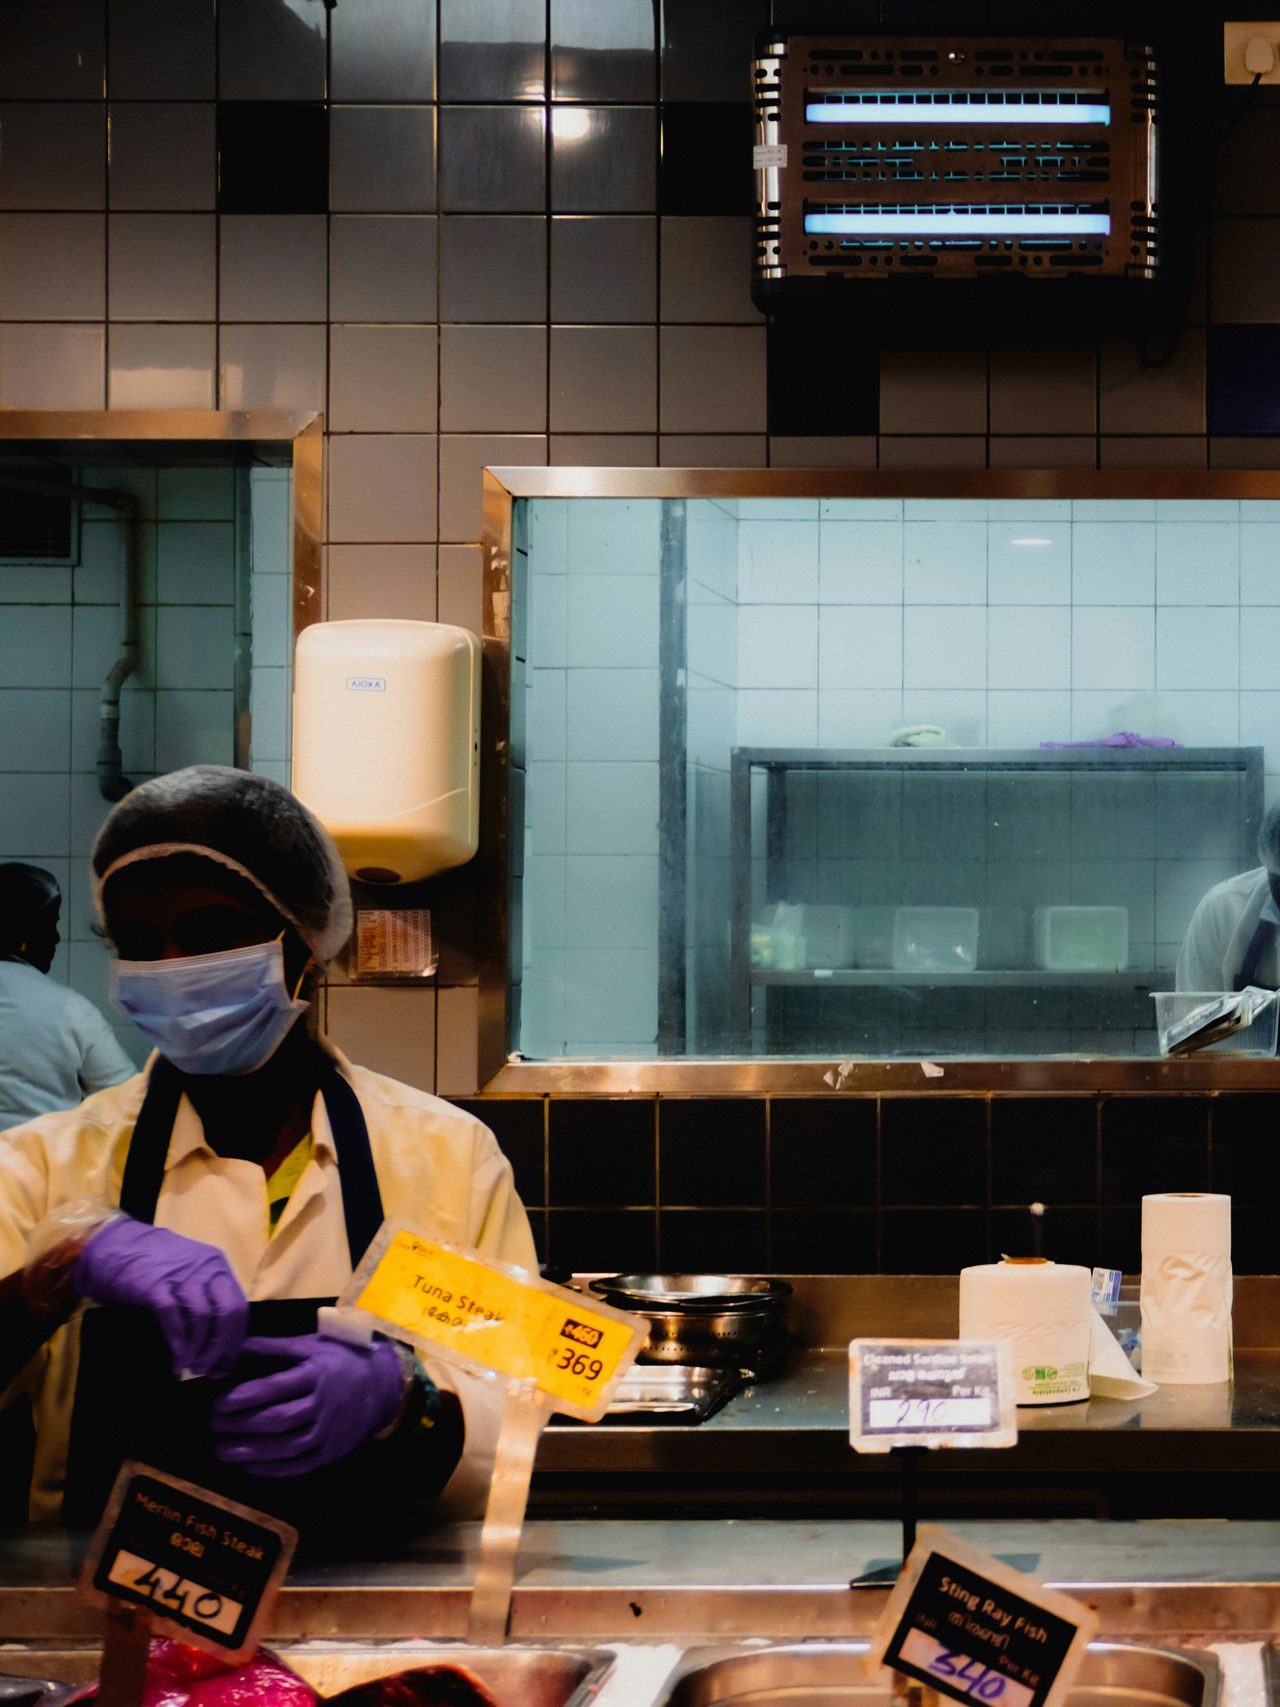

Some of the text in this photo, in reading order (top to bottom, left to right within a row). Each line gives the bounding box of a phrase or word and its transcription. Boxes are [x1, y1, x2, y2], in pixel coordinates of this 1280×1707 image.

[412, 1275, 505, 1322] Tuna Steak
[863, 1354, 911, 1366] Cleaned
[952, 1385, 972, 1396] Per
[136, 1493, 264, 1560] Merlin Fish Steak
[133, 1564, 222, 1618] 440
[939, 1576, 1049, 1644] Sting Ray Fish
